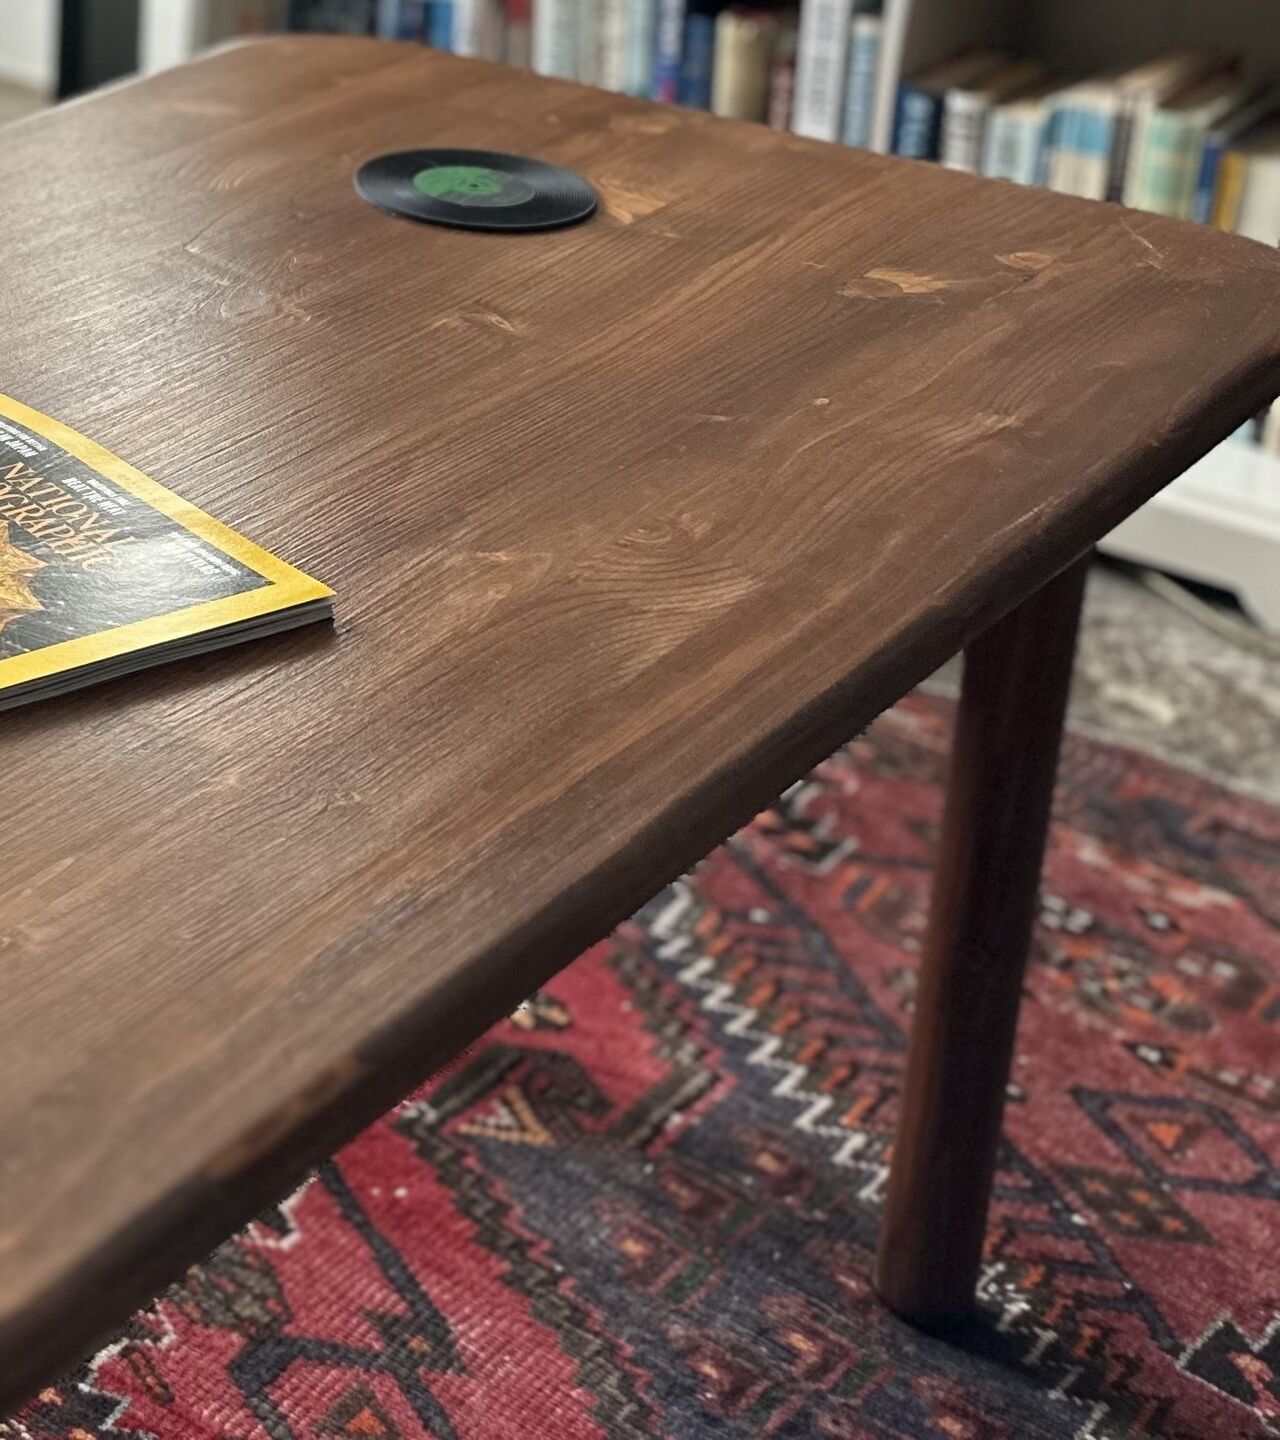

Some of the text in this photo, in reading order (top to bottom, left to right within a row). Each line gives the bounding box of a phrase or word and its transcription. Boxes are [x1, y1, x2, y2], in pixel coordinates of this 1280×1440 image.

[5, 440, 38, 458] JAPAN
[61, 477, 127, 515] BEAT THE HEAT
